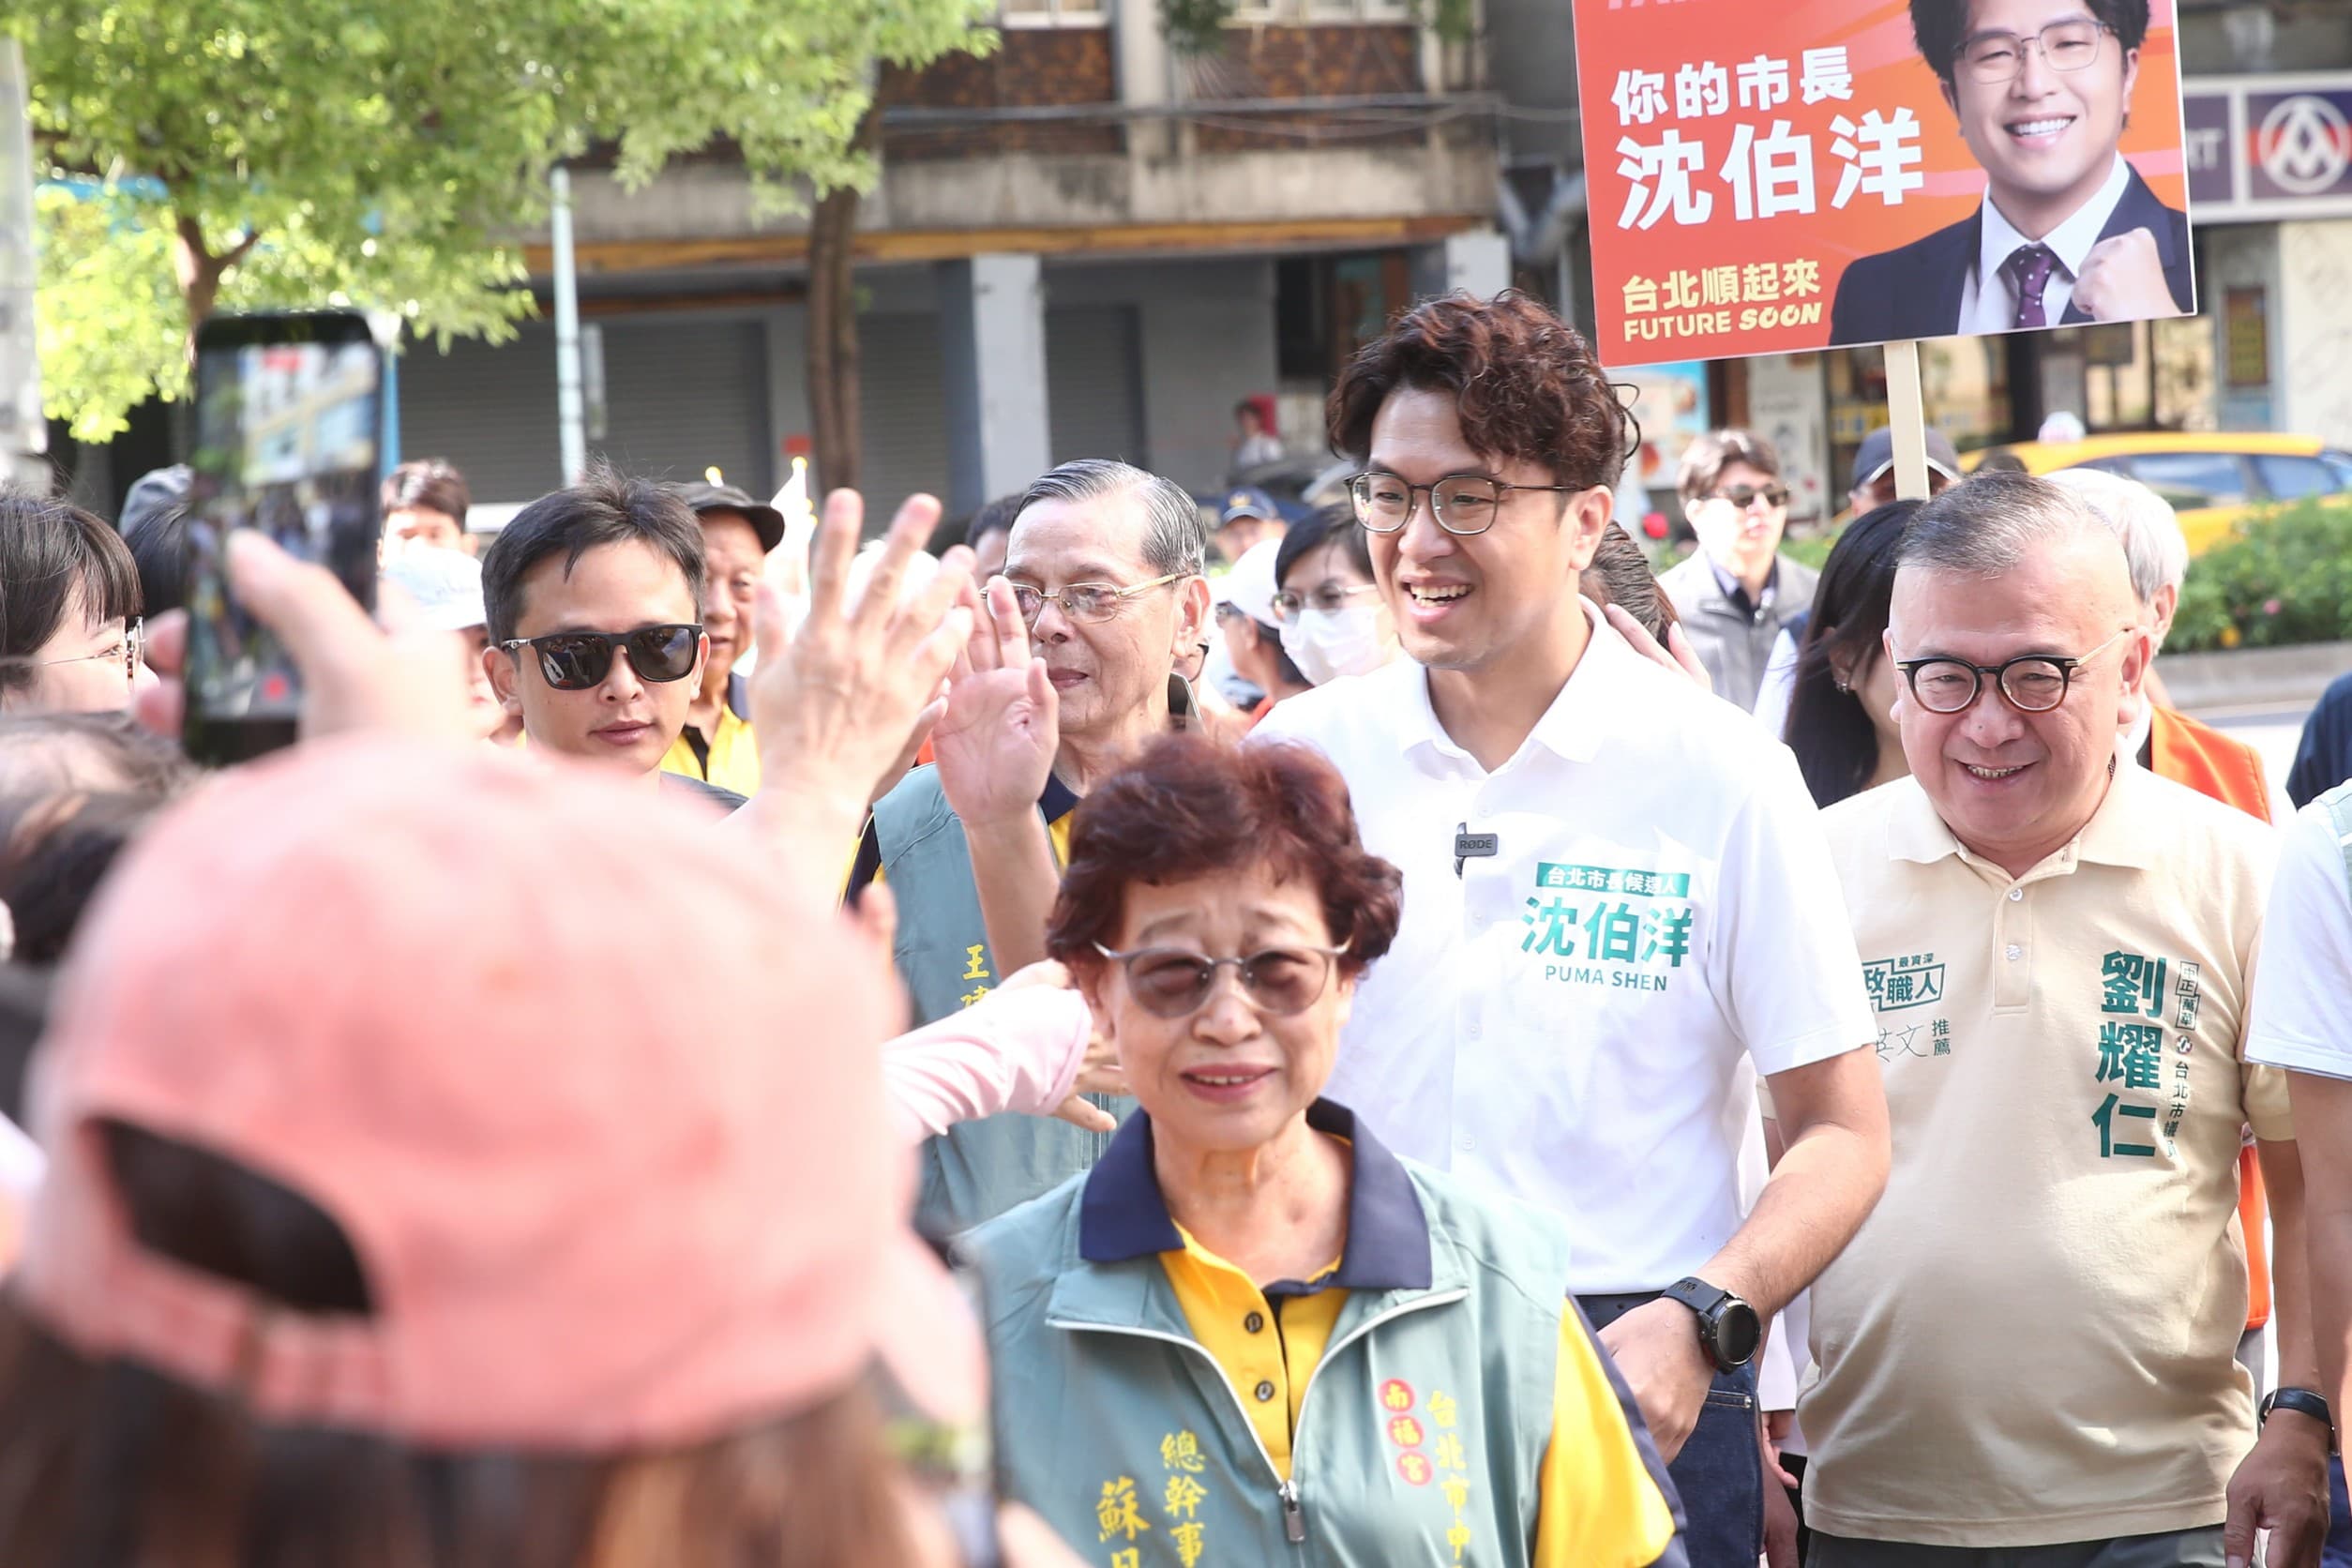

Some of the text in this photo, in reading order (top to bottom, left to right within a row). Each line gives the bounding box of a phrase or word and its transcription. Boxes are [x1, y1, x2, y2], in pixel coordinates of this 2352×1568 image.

[1610, 45, 1854, 127] 你的市長
[1615, 106, 1924, 231] 沈伯洋
[1621, 258, 1821, 314] 台北順起來
[1623, 302, 1822, 342] FUTURE SOON
[1547, 866, 1680, 896] 台北市長候選人
[1520, 896, 1693, 968] 沈伯洋
[1545, 964, 1667, 991] PUMA SHEN
[1931, 1018, 1951, 1057] 推薦
[2091, 950, 2167, 1158] 劉耀仁
[1384, 1382, 1425, 1483] 南福宮
[1159, 1429, 1208, 1568] 總幹事
[1425, 1389, 1471, 1568] 台北市中
